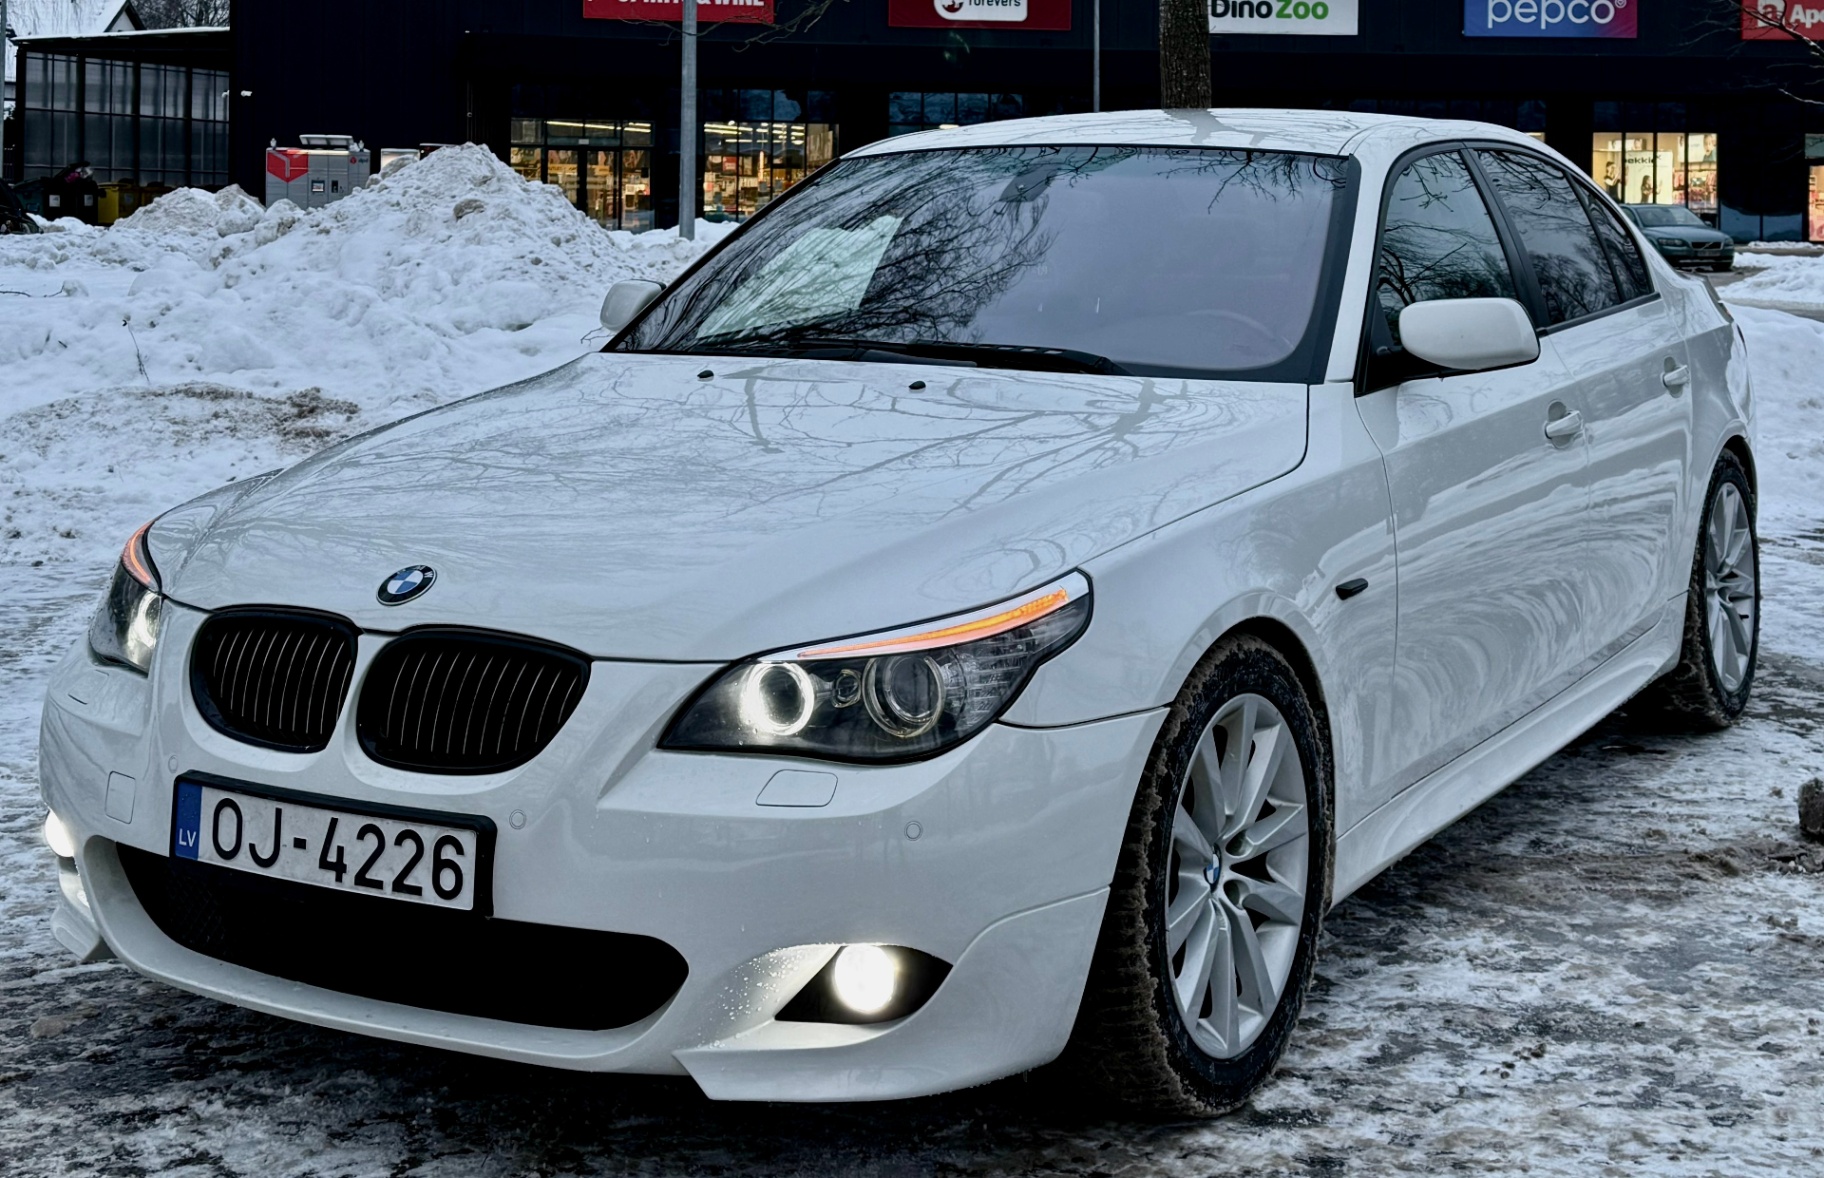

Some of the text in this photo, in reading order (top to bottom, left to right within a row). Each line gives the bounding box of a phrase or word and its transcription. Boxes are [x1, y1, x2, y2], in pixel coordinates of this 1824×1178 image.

[1488, 0, 1615, 29] pepco
[179, 797, 465, 900] LV OJ-4226
